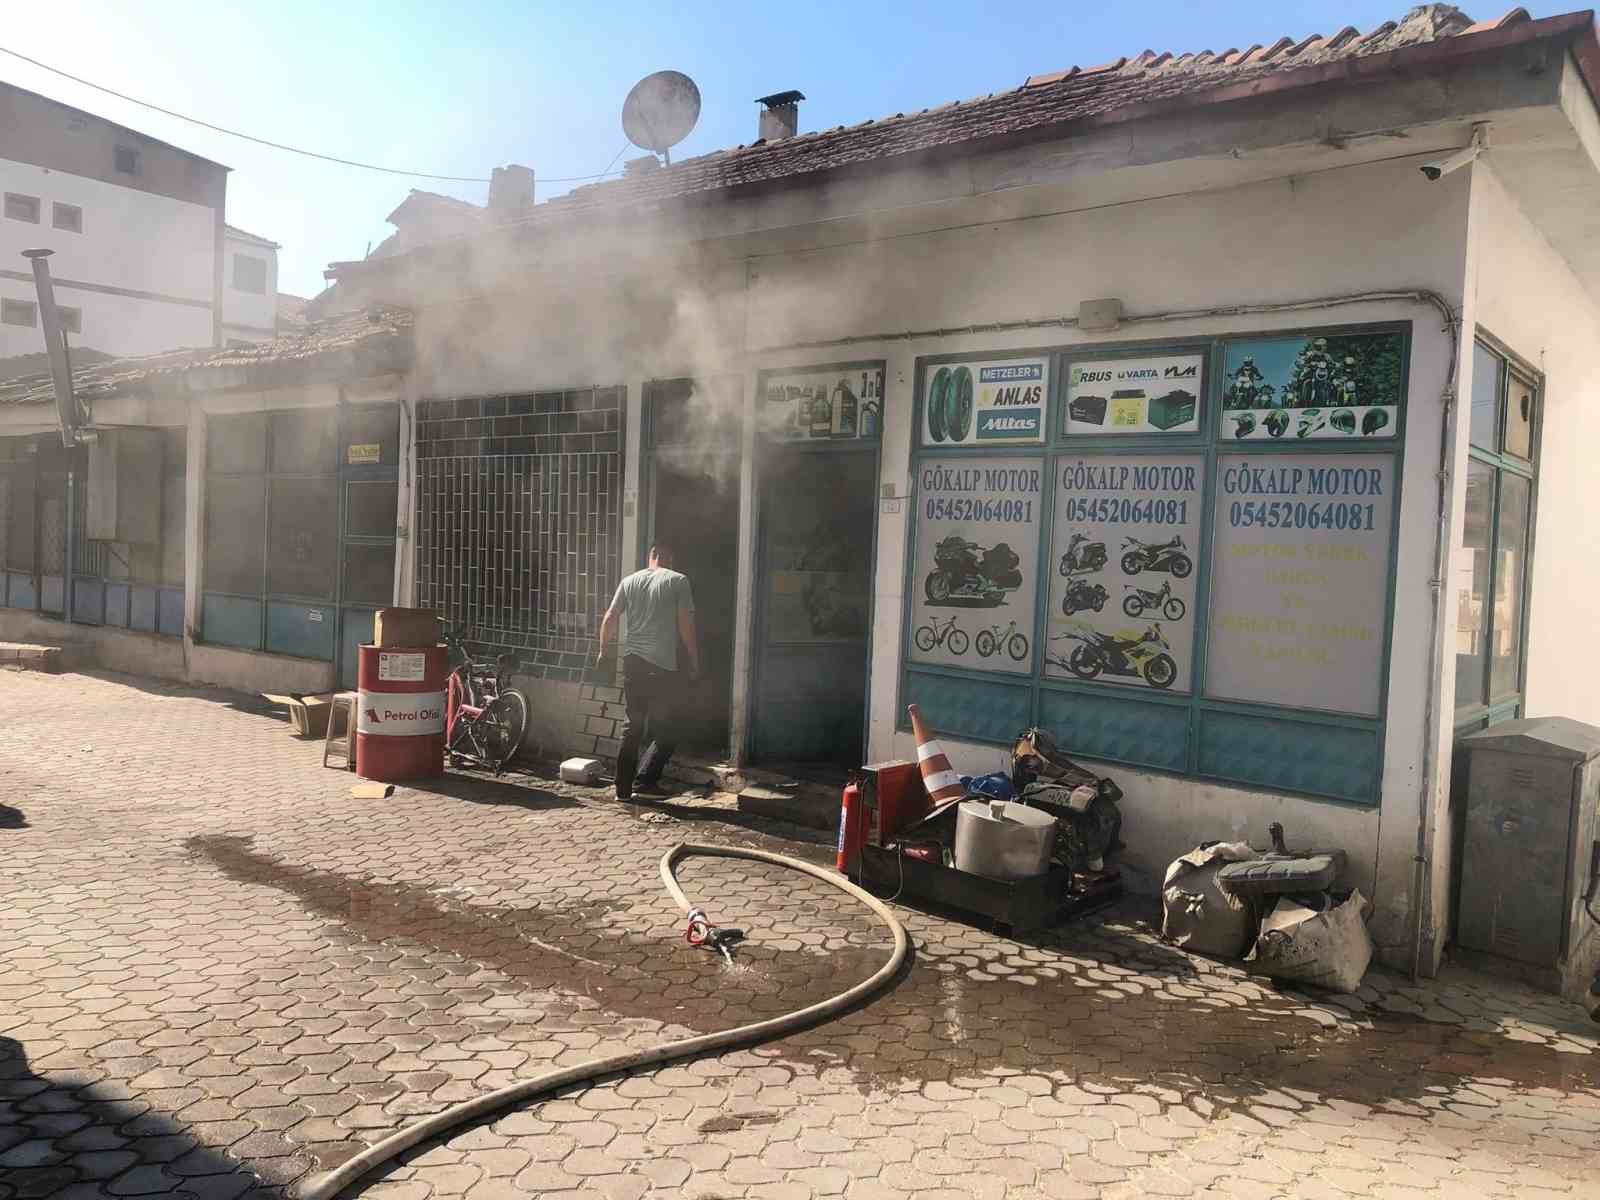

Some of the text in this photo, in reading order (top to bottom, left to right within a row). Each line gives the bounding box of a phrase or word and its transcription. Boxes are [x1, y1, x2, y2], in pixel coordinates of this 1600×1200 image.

[982, 367, 1031, 379] METZELER
[1126, 369, 1158, 379] VARTA
[993, 386, 1041, 406] ANLAS
[923, 465, 1040, 492] GÖKALP MOTOR
[1063, 461, 1196, 491] GÖKALP MOTOR
[1224, 462, 1383, 495] GÖKALP MOTOR
[926, 498, 1033, 523] 05452064081
[1066, 498, 1188, 524] 05452064081
[1230, 501, 1375, 530] 05452064081
[384, 709, 418, 721] Petrol
